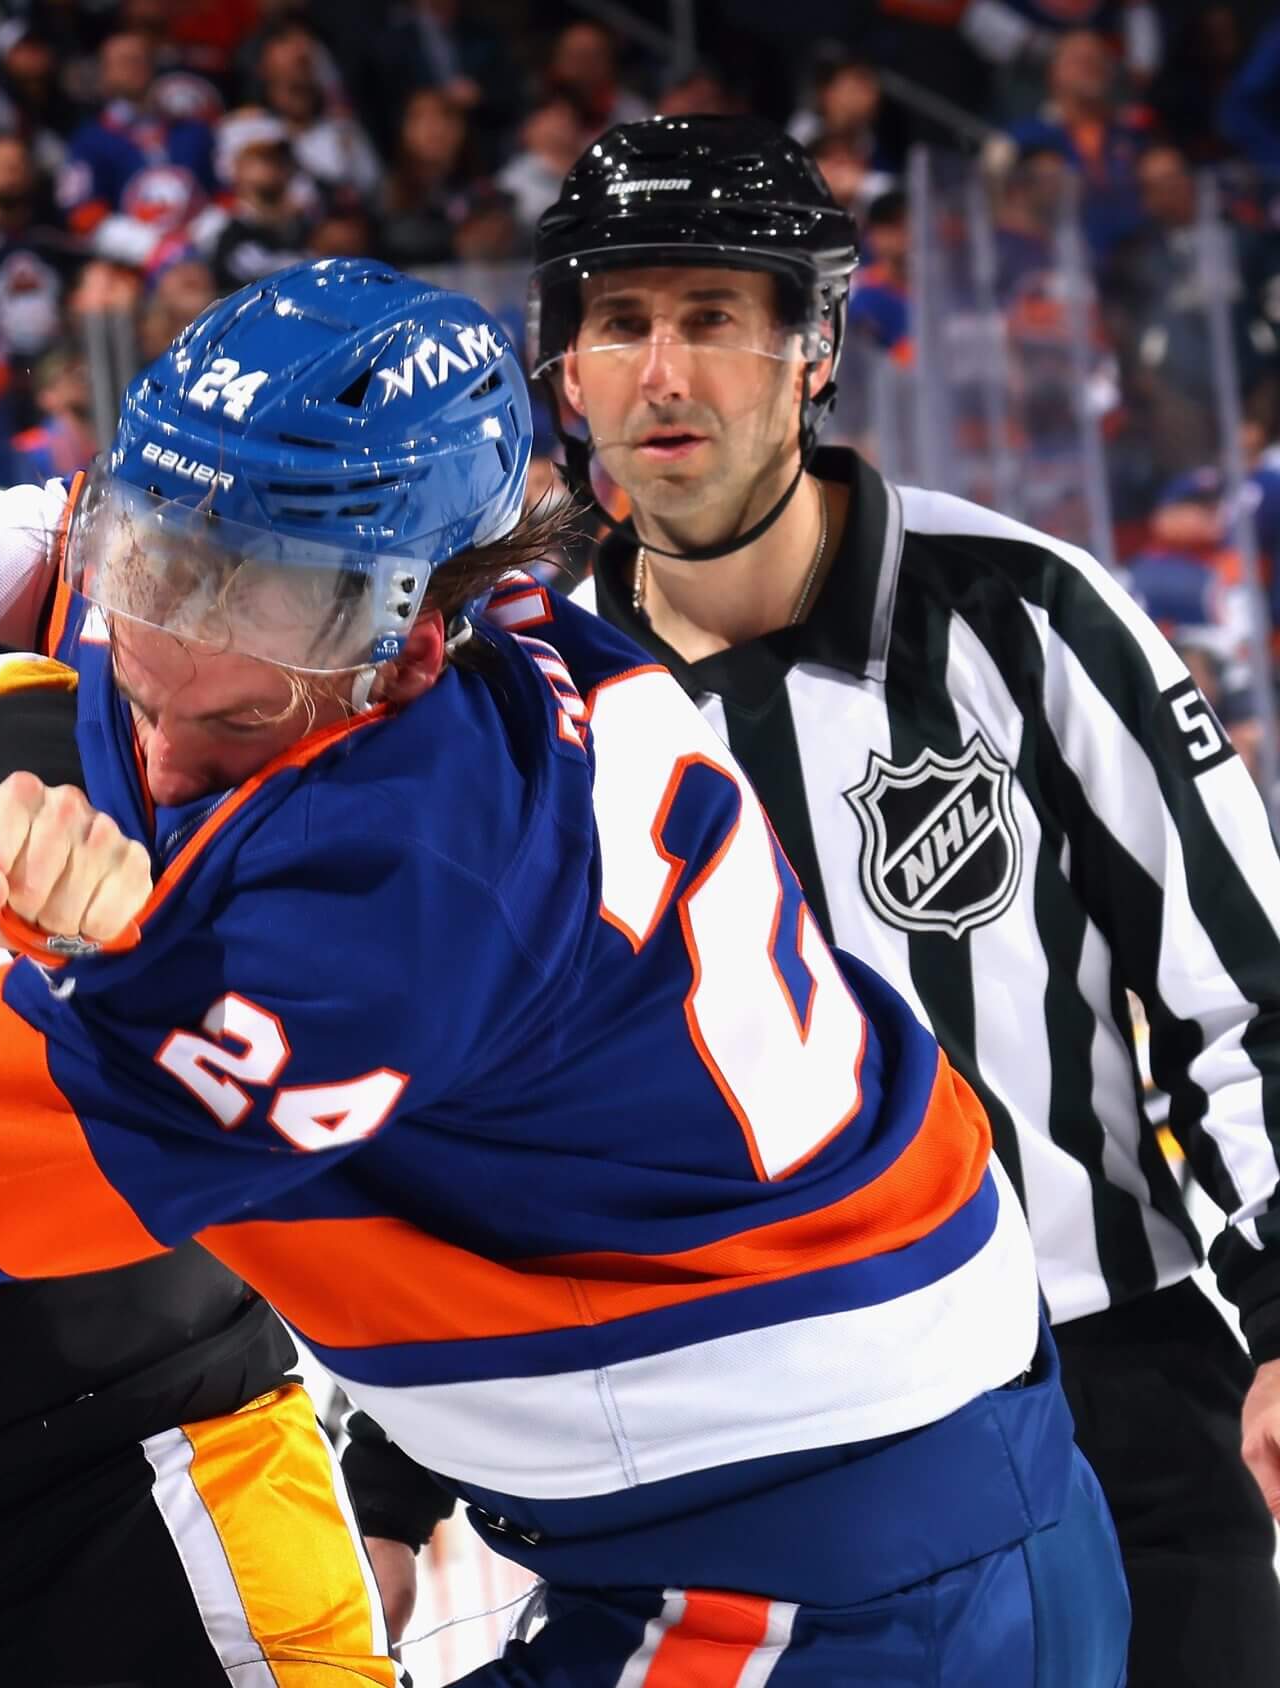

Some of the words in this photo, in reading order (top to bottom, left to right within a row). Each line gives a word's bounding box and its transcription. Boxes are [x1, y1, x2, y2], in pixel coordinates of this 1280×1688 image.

[606, 179, 691, 195] WARRIOR
[188, 357, 271, 422] 24
[141, 441, 235, 490] BAUER
[1169, 686, 1232, 762] 5
[900, 791, 995, 902] NHL
[155, 990, 410, 1153] 24
